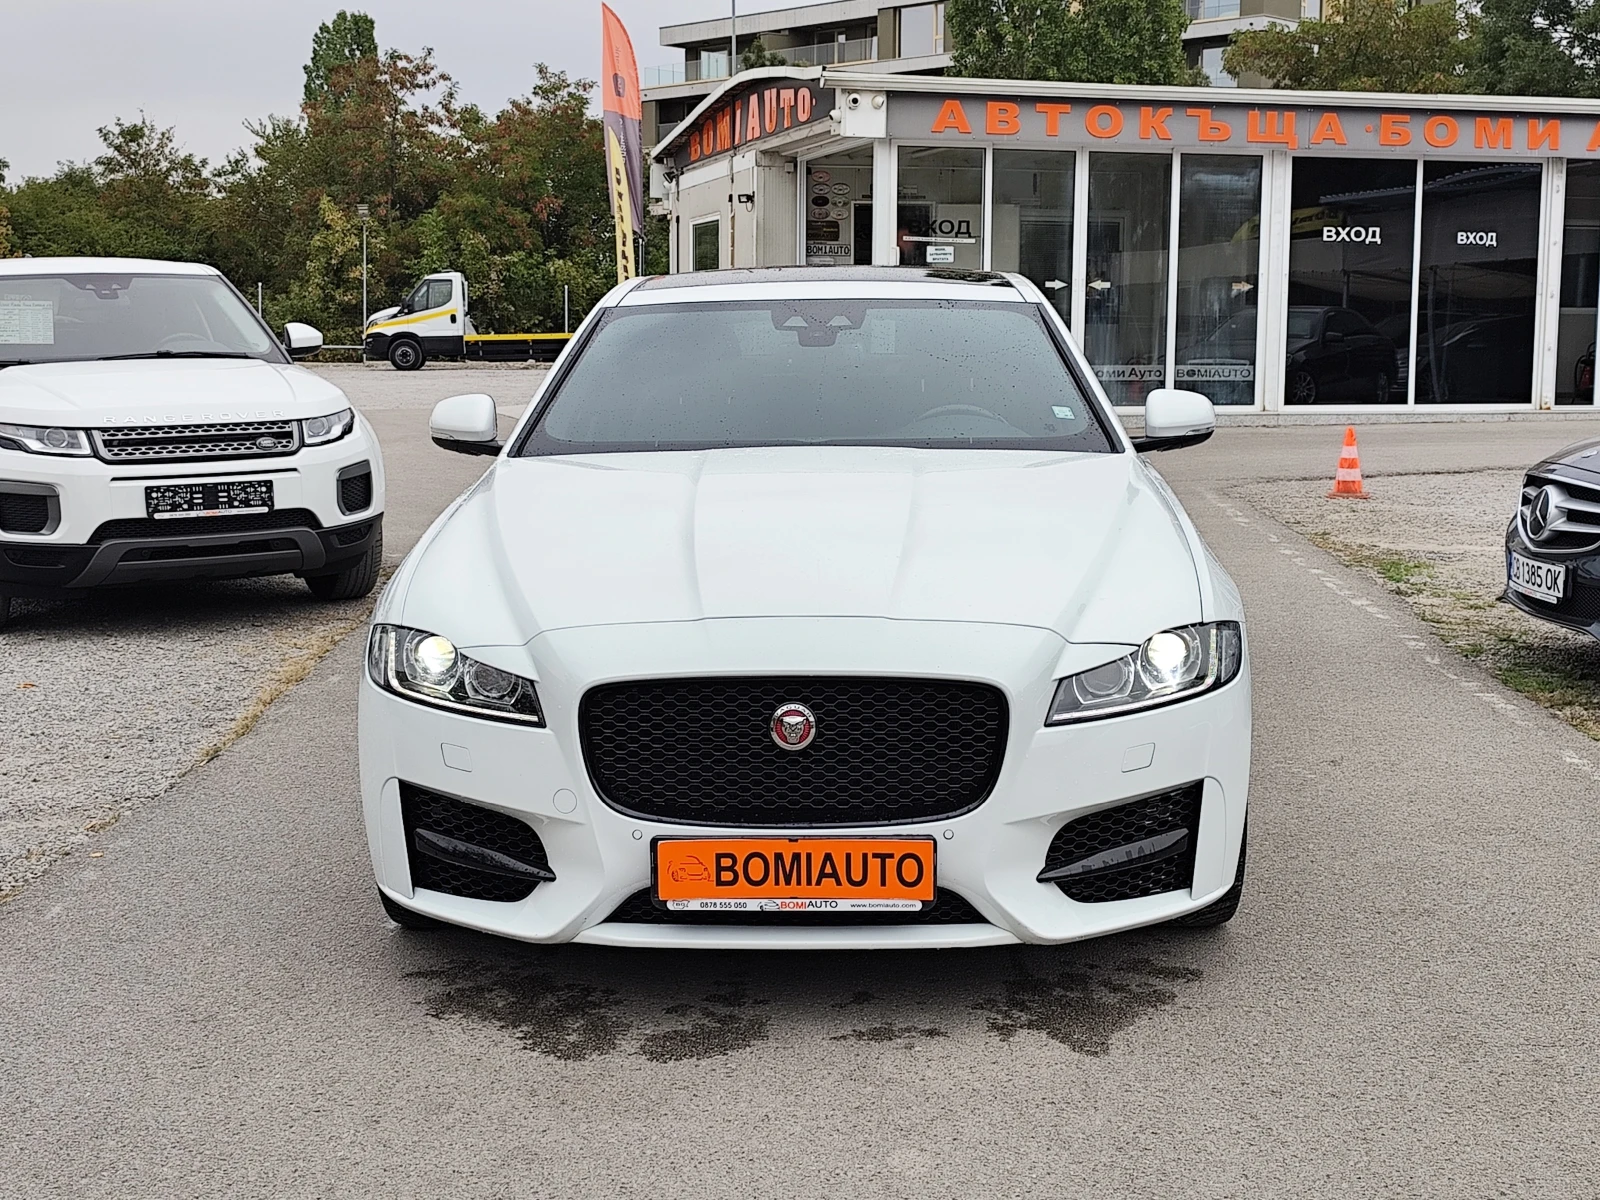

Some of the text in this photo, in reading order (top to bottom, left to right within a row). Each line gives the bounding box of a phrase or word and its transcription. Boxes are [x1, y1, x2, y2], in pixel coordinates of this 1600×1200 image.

[688, 87, 812, 162] BOMIAUTO
[931, 99, 1348, 150] АВТОКЪЩА
[1379, 114, 1562, 151] БОМИ
[1322, 226, 1381, 245] ВХОД
[1456, 231, 1498, 247] ВХОД
[806, 245, 850, 255] BOMIAUTO
[1093, 367, 1163, 380] оми Ауто
[1176, 367, 1252, 378] BOMIAUTO
[103, 409, 287, 424] RANGE ROVER
[1521, 560, 1543, 588] 1385
[1545, 568, 1562, 594] OK
[714, 851, 924, 887] BOMIAUTO
[780, 900, 838, 910] BOMIAUTO
